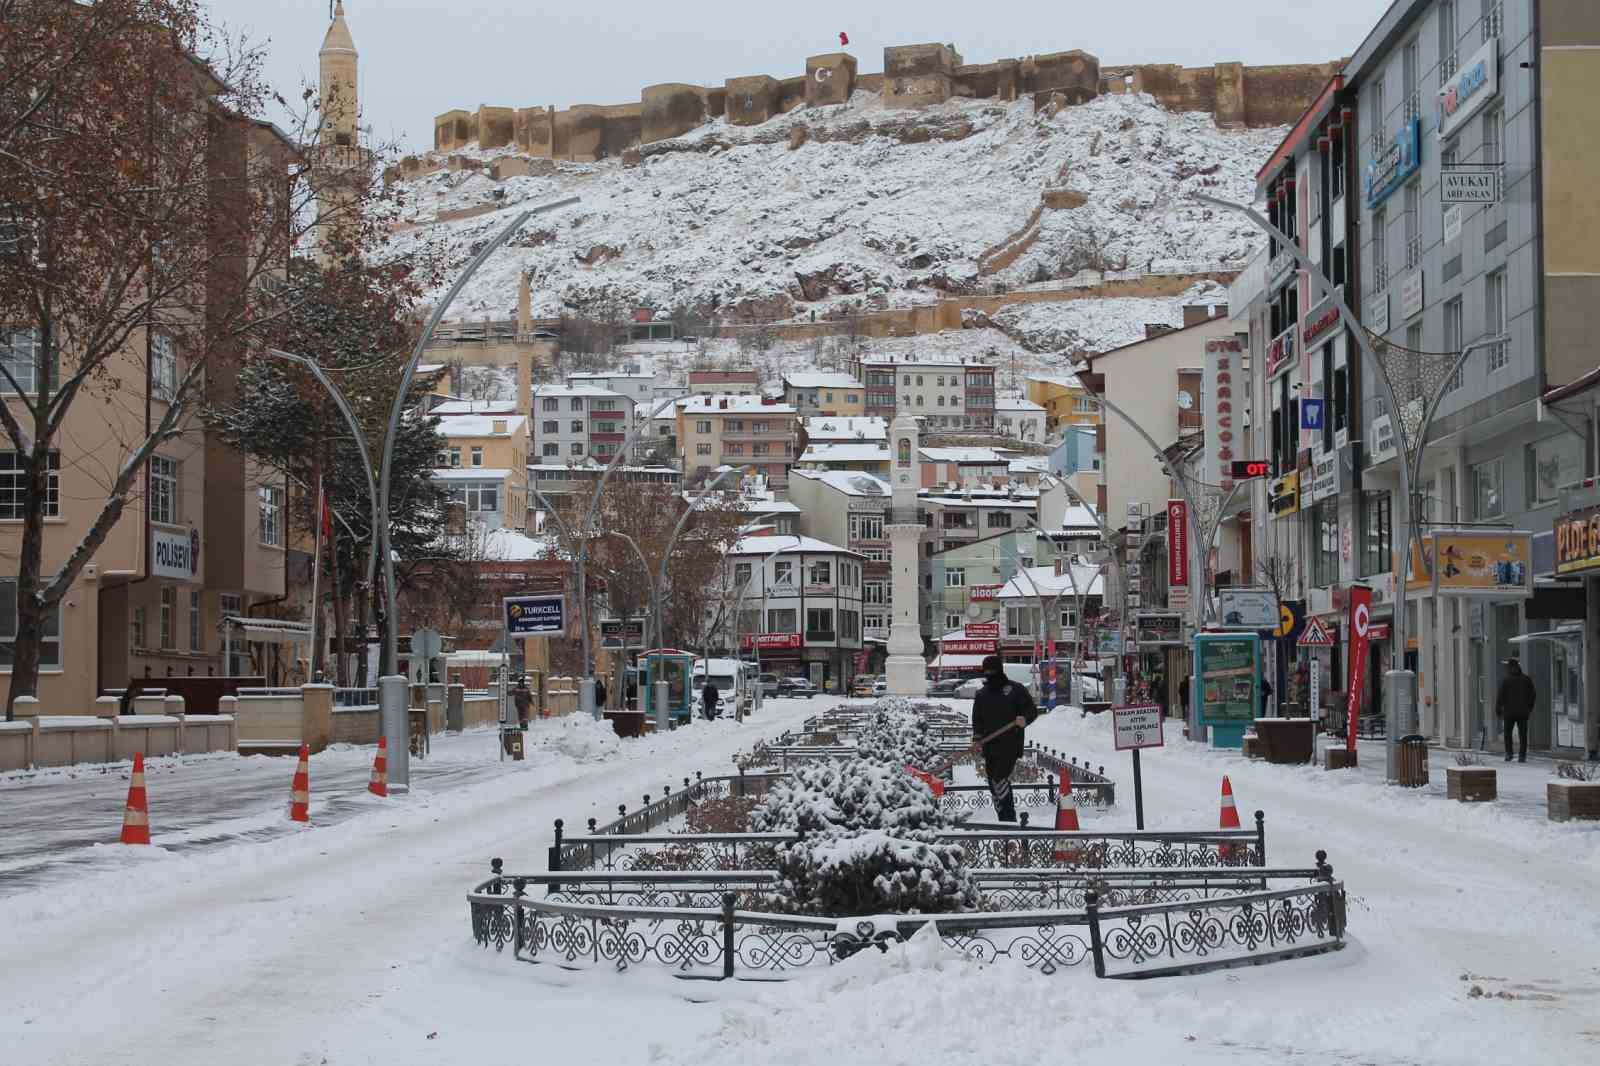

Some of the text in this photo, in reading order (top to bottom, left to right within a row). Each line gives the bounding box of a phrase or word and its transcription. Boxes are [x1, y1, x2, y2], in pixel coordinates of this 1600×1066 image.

[1447, 176, 1489, 187] AVUKAT
[156, 537, 190, 569] POLİSEVİ
[524, 604, 561, 615] TURKCELL
